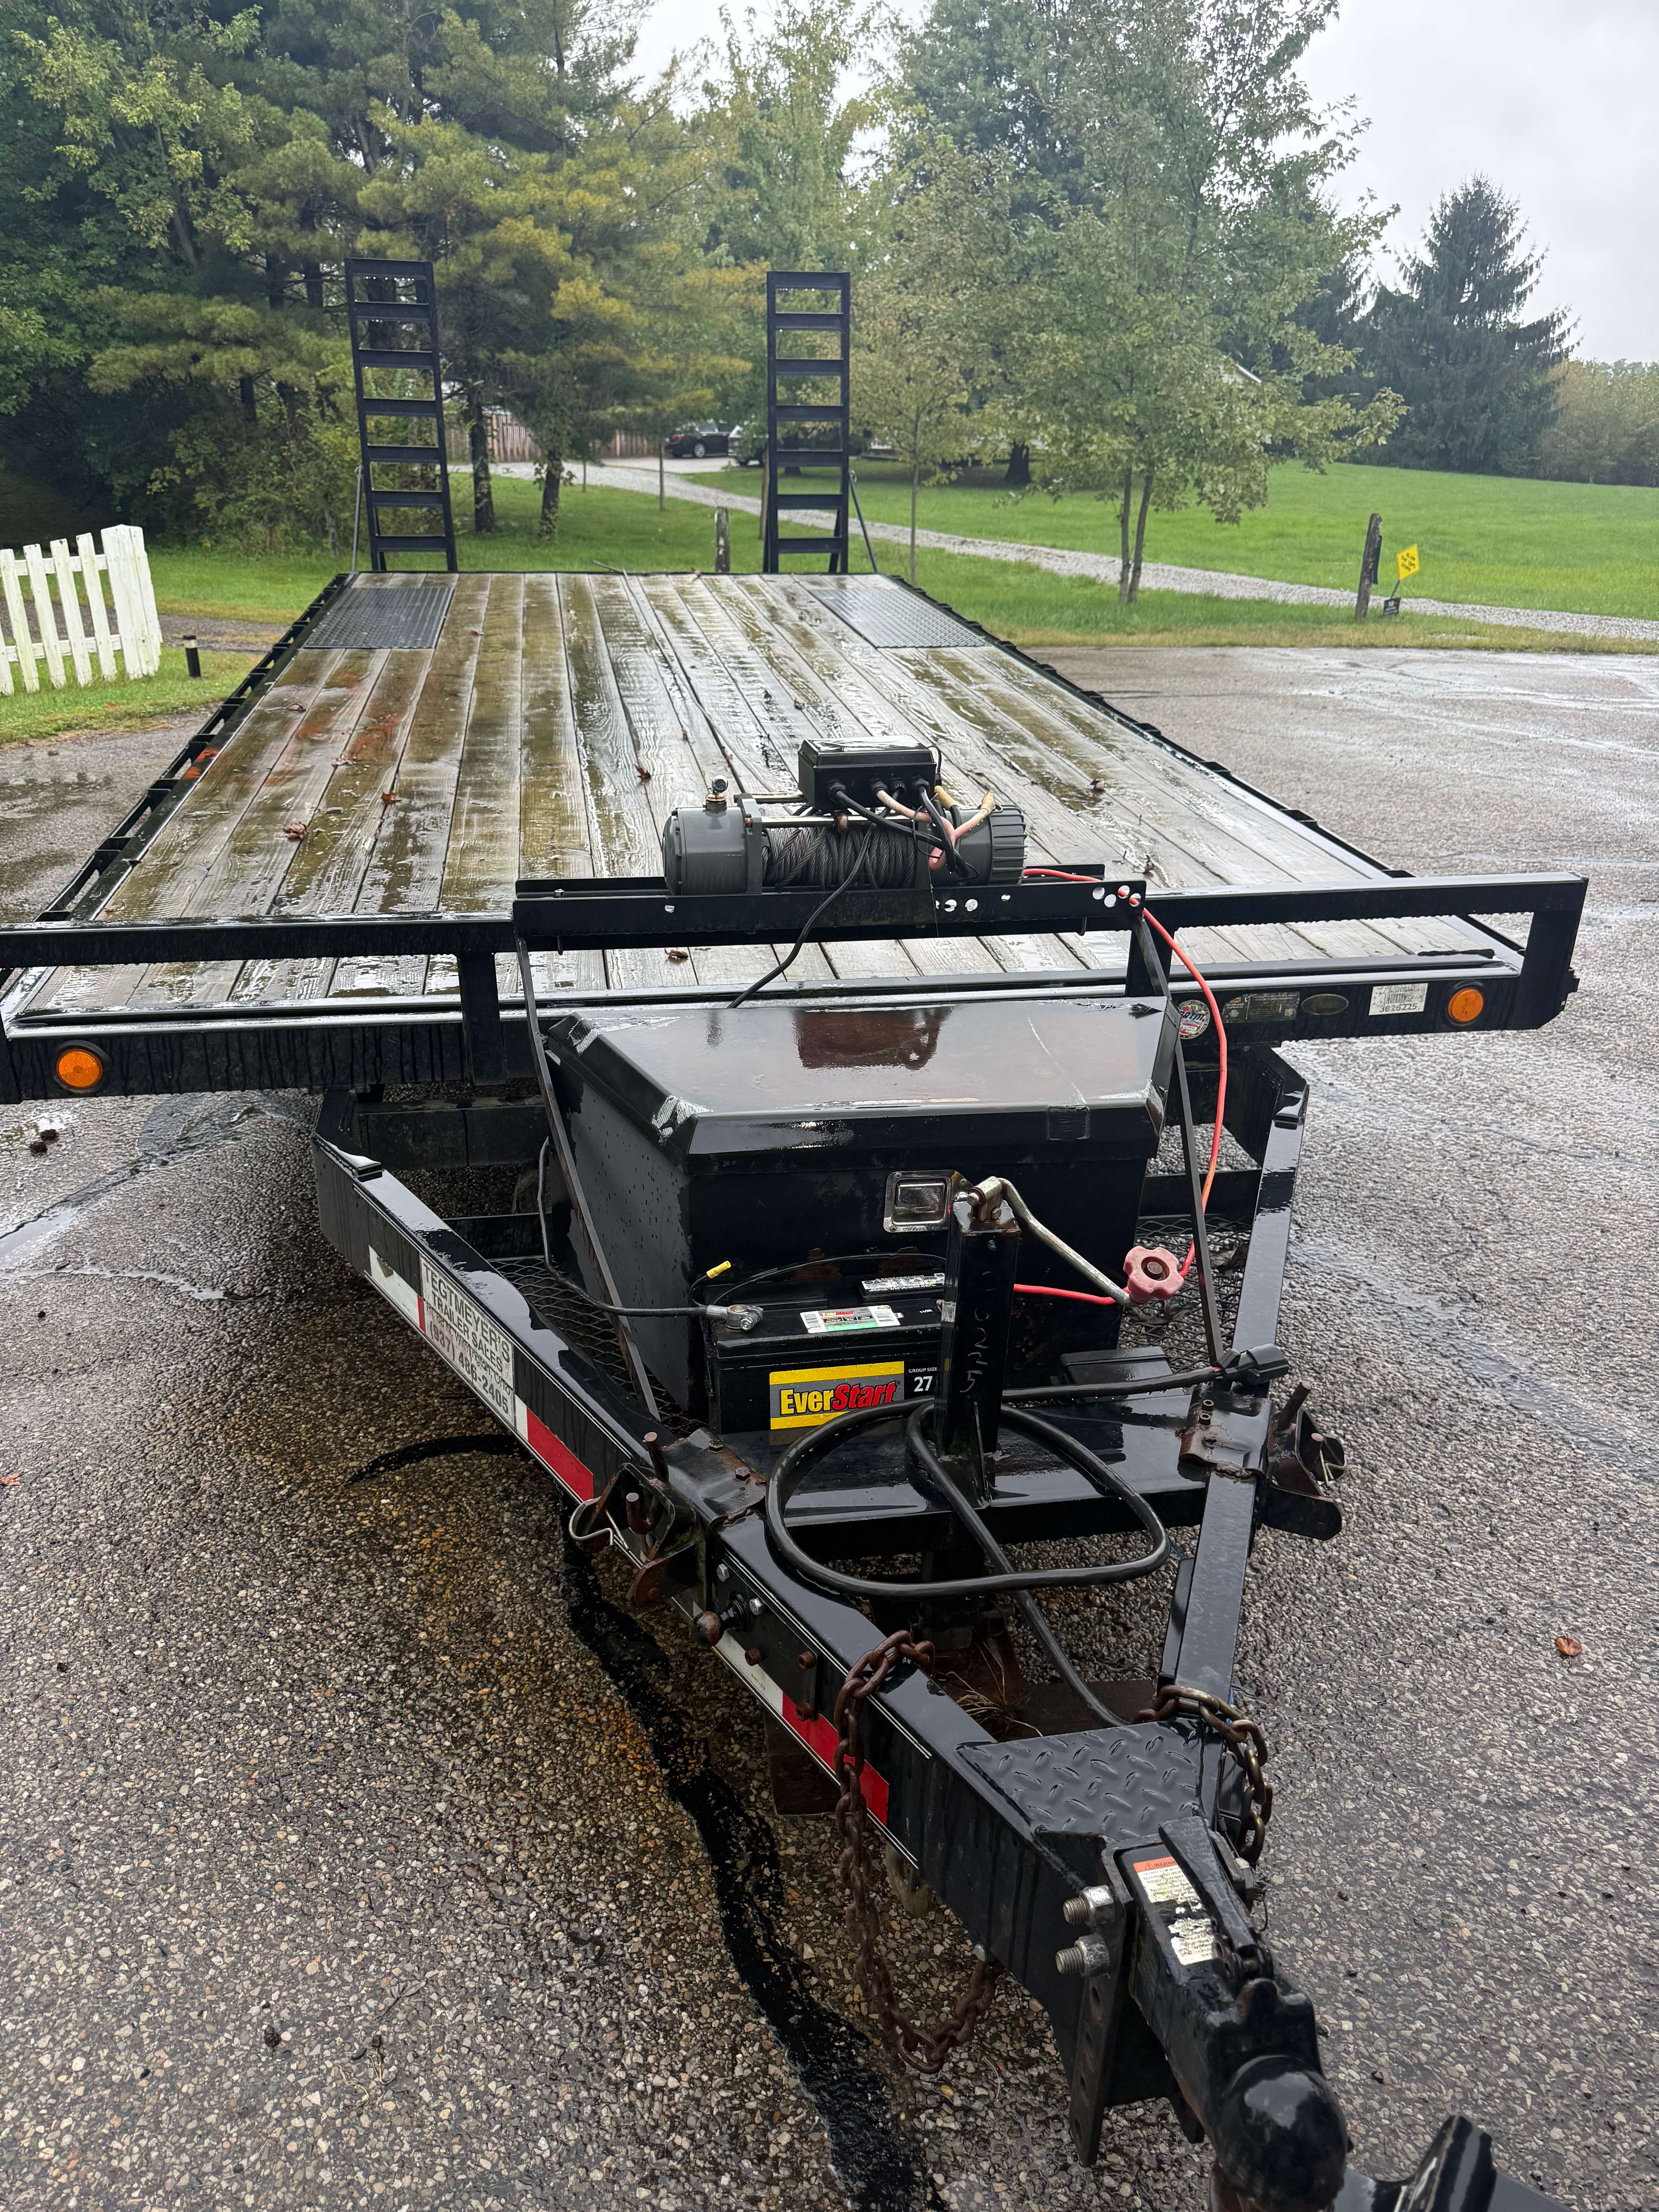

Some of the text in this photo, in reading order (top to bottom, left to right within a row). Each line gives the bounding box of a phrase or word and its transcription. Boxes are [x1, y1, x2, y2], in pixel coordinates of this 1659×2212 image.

[1379, 1003, 1417, 1012] 3026225
[423, 1262, 510, 1363] TEGTMEYER'S
[432, 1290, 503, 1373] TRAILER SALES
[430, 1321, 508, 1414] (937) 486-2405
[455, 1332, 492, 1379] Wilmington,
[494, 1371, 510, 1395] Ohio
[914, 1376, 933, 1392] 27
[780, 1380, 897, 1415] EverStart
